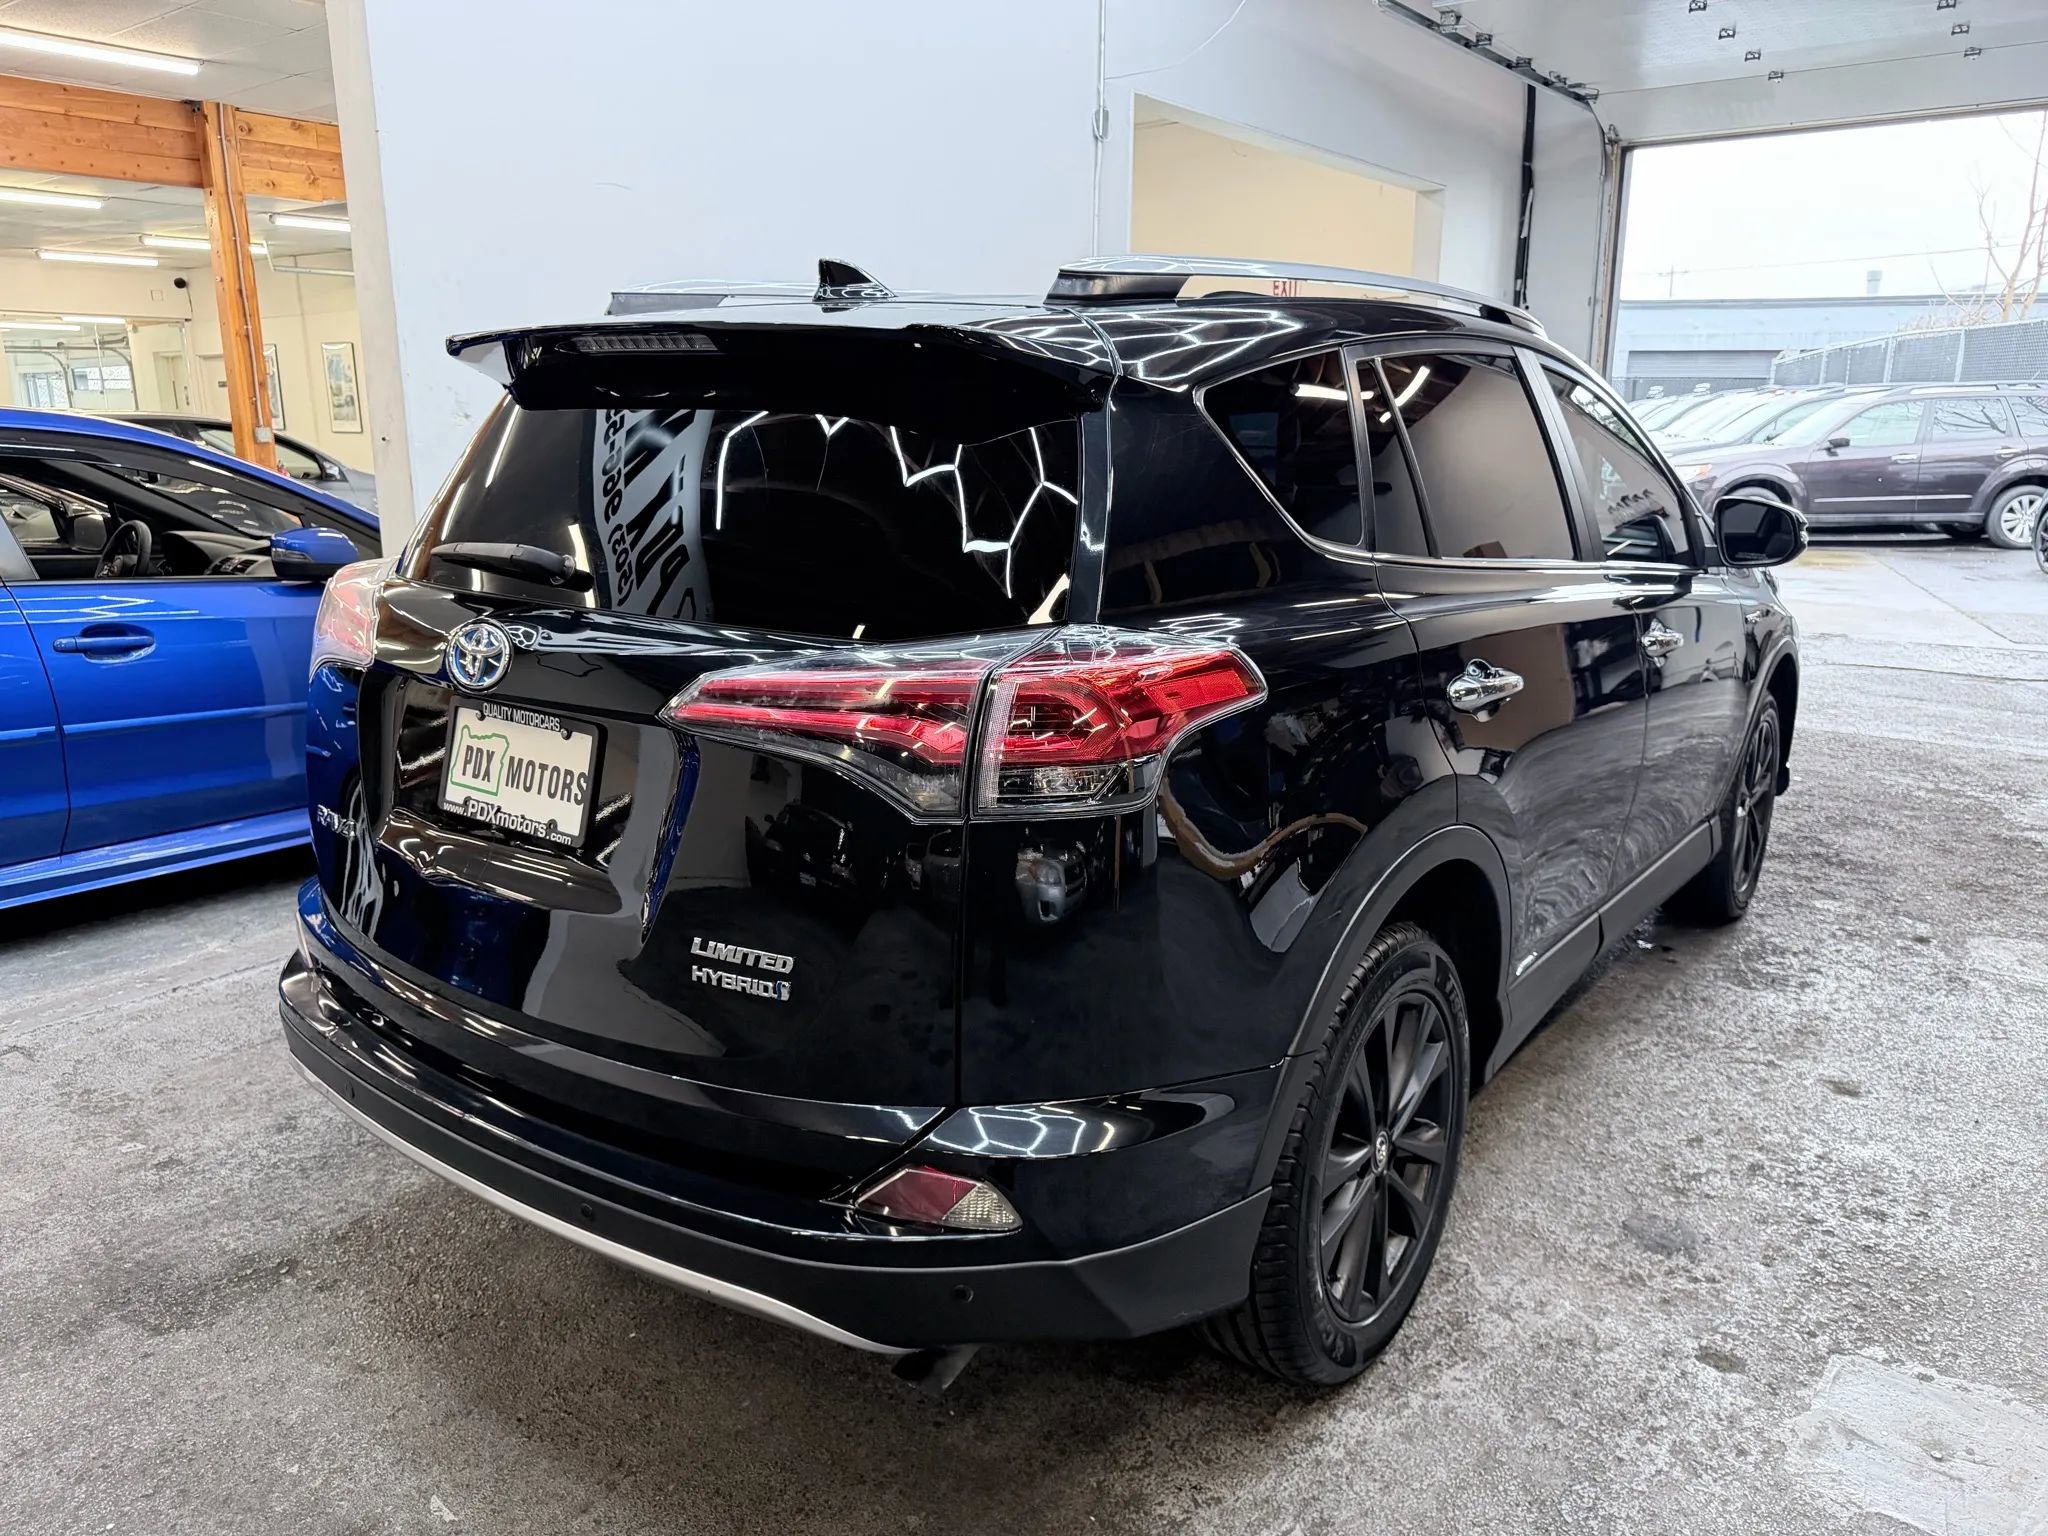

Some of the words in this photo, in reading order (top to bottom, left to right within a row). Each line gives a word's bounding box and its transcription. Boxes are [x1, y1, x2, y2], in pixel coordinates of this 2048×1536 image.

[482, 702, 513, 722] QUALITY
[513, 708, 561, 732] MOTORCARS
[461, 744, 496, 783] PDX
[504, 755, 589, 806] MOTORS
[317, 804, 356, 838] RAV4
[442, 799, 572, 846] www.PDXmotors.com
[690, 937, 794, 974] LIMITED
[691, 965, 773, 998] HYBRID
